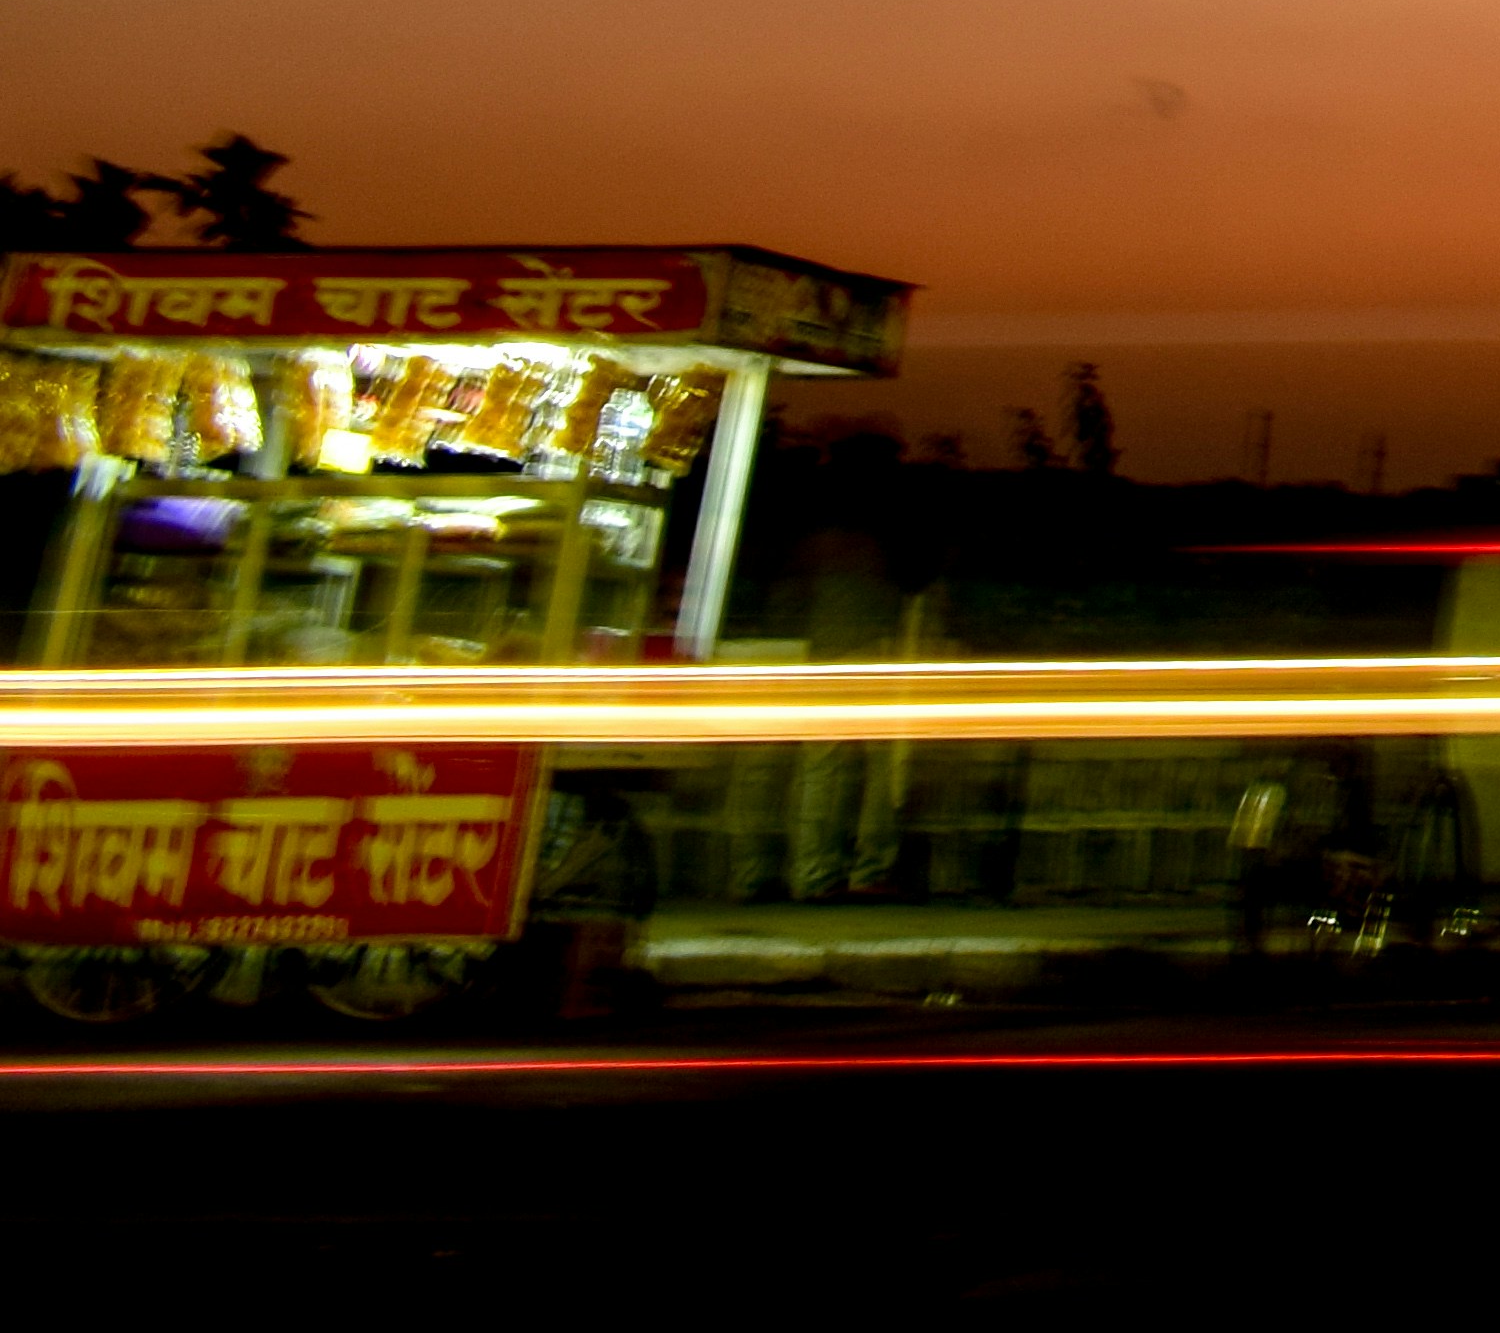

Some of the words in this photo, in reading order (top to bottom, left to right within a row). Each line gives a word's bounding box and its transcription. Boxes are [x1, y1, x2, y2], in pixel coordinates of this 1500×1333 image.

[41, 256, 288, 332] शिवम
[312, 276, 473, 329] चाट
[488, 252, 673, 329] सेंटर
[6, 758, 206, 914] शिवम
[207, 795, 354, 907] चाट
[355, 748, 511, 907] सेंटर
